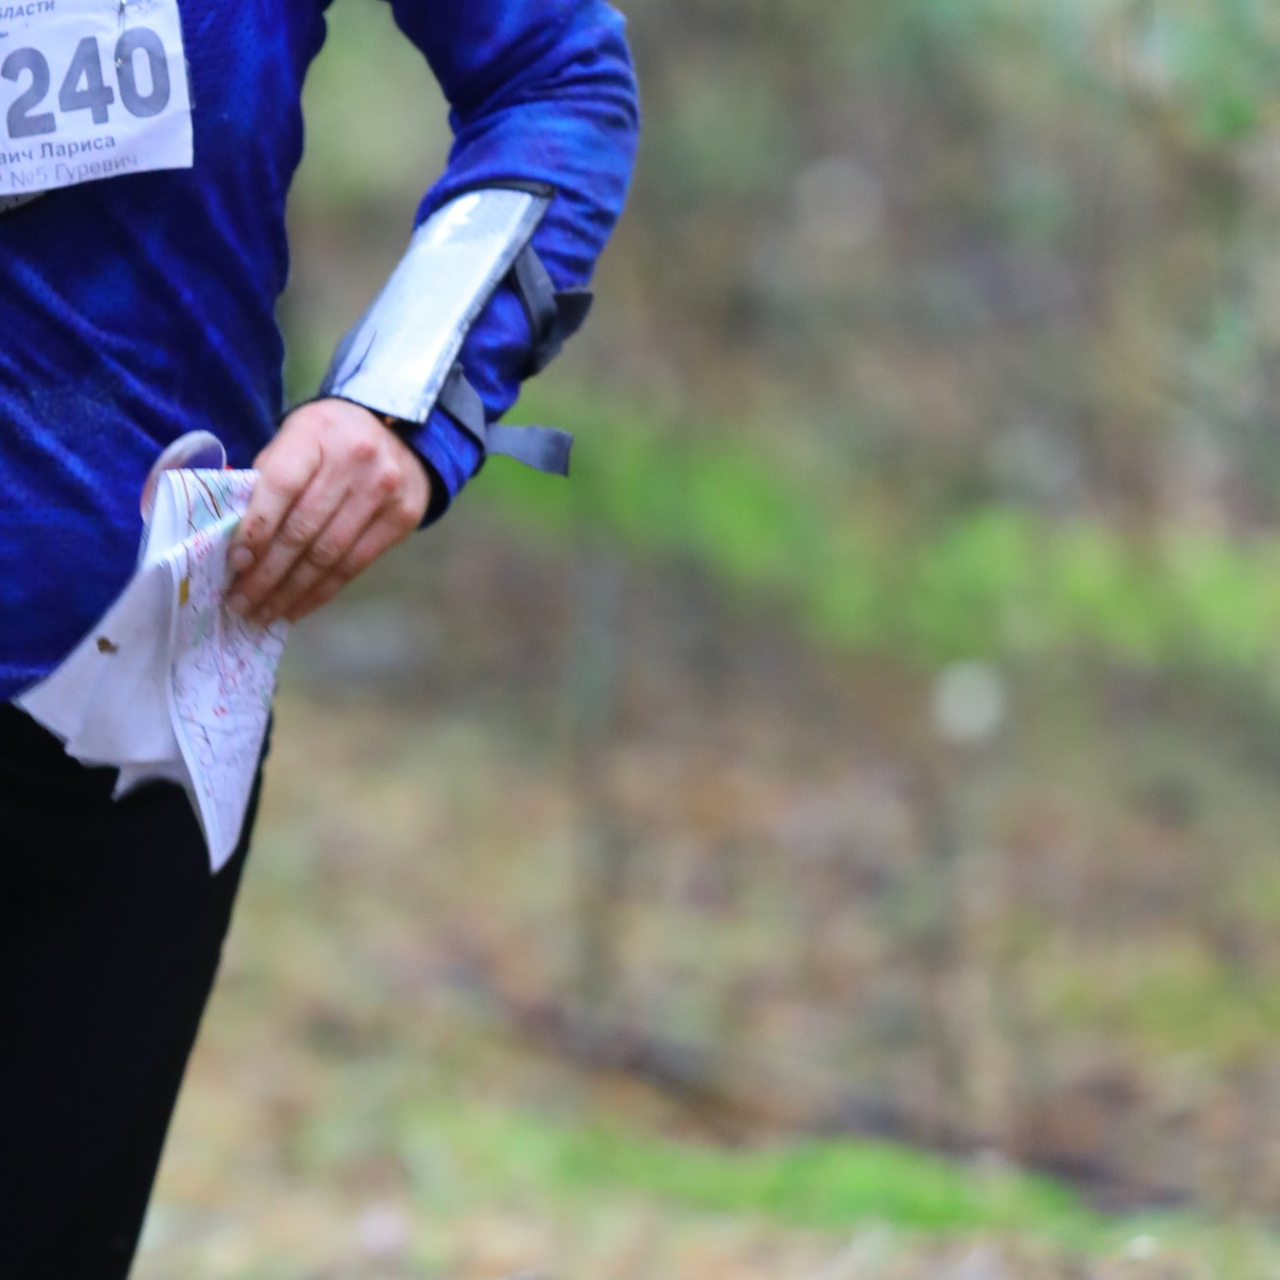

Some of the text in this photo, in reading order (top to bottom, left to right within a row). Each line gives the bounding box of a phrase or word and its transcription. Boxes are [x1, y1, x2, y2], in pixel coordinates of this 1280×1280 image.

[0, 27, 171, 139] 240
[40, 135, 116, 159] Лариса
[54, 154, 138, 181] Гуревич
